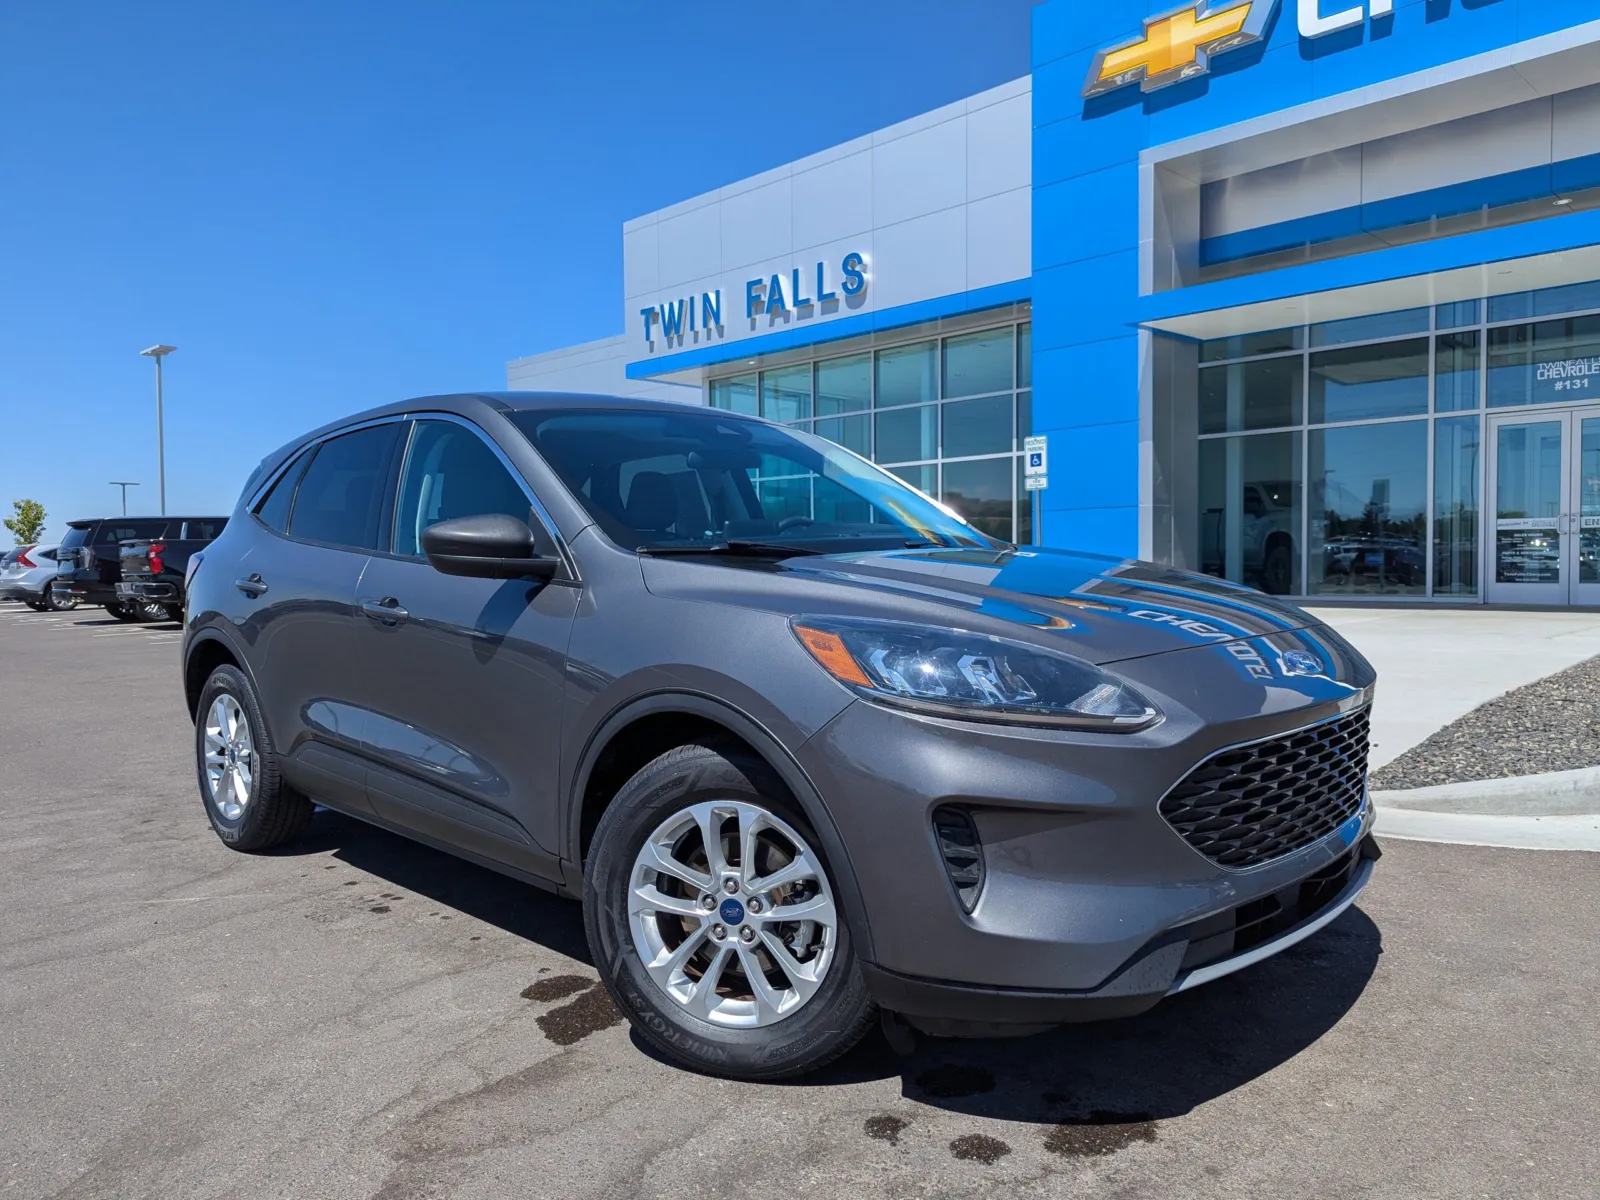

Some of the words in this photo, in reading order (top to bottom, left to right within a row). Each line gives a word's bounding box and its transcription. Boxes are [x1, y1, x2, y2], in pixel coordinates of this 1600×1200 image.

[640, 289, 721, 342] TWIN
[746, 252, 866, 319] FALLS
[1554, 378, 1589, 391] #131
